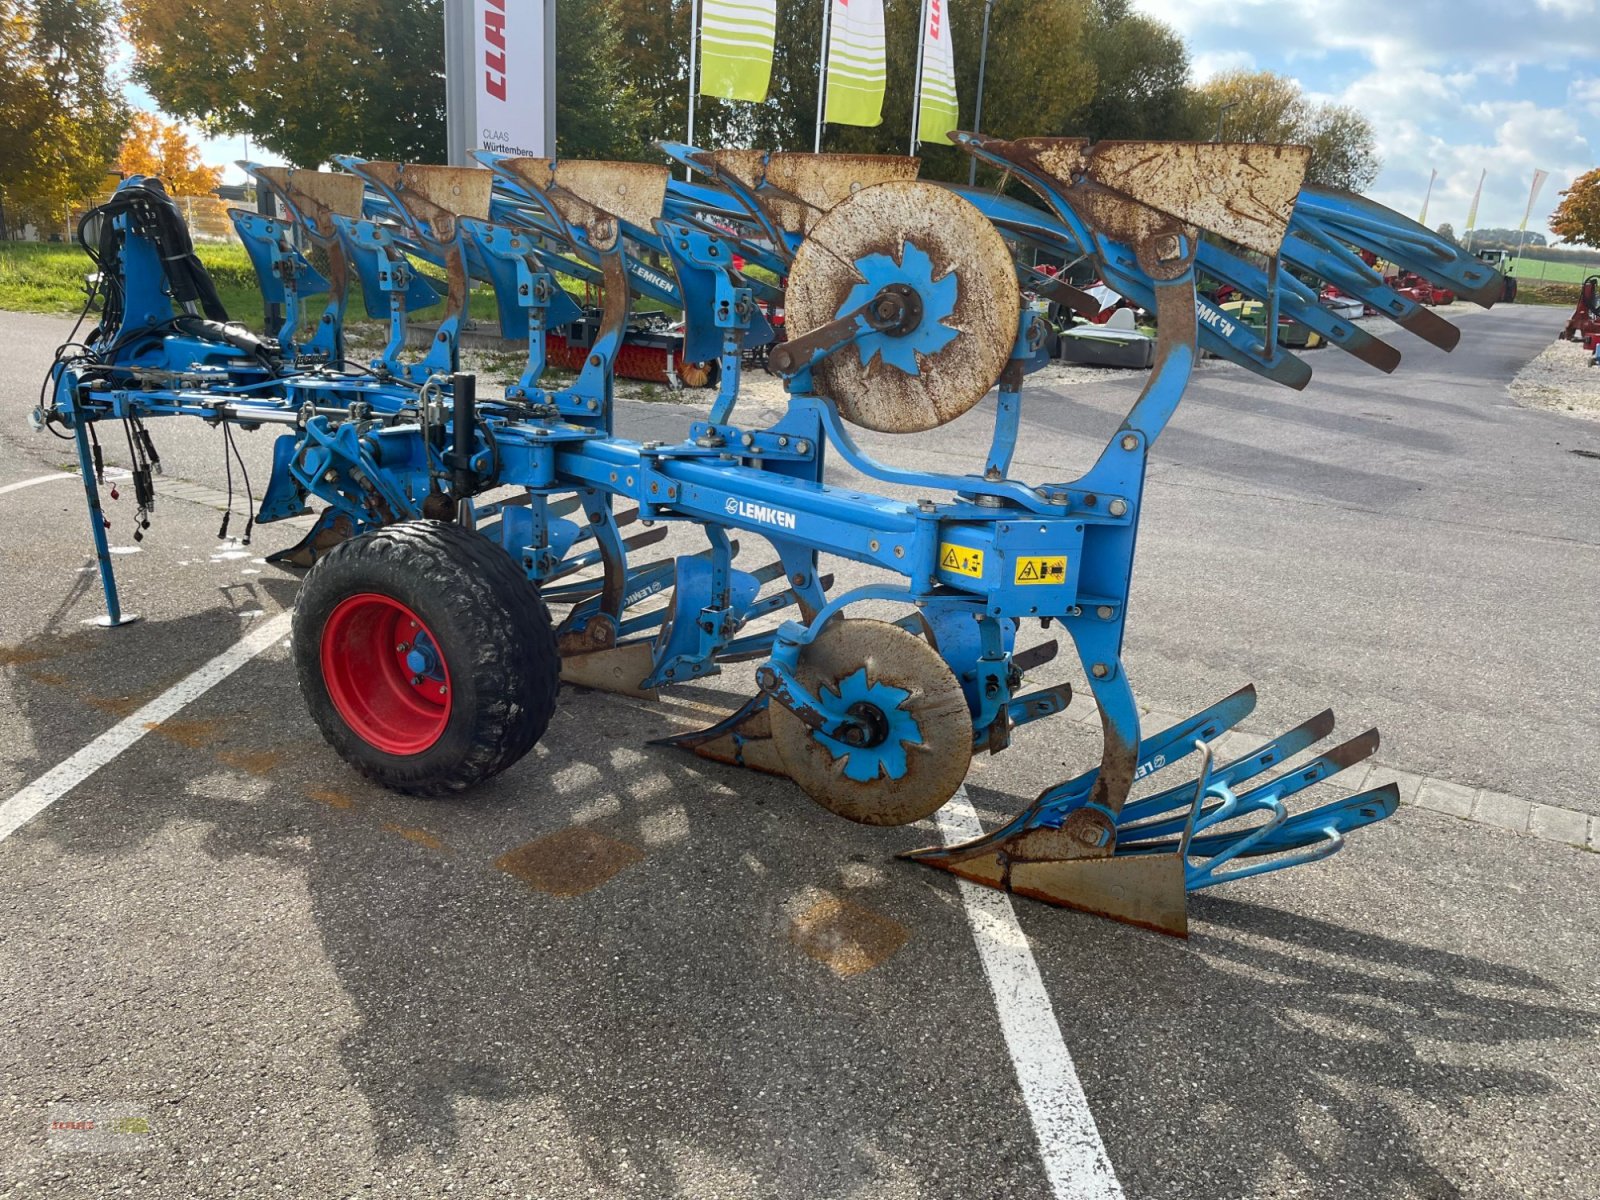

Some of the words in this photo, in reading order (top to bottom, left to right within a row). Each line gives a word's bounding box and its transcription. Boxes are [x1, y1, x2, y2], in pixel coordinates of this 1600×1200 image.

[485, 0, 506, 102] CLA
[483, 128, 510, 142] CLAAS
[631, 263, 674, 293] LEMKEN
[739, 501, 796, 530] LEMKEN
